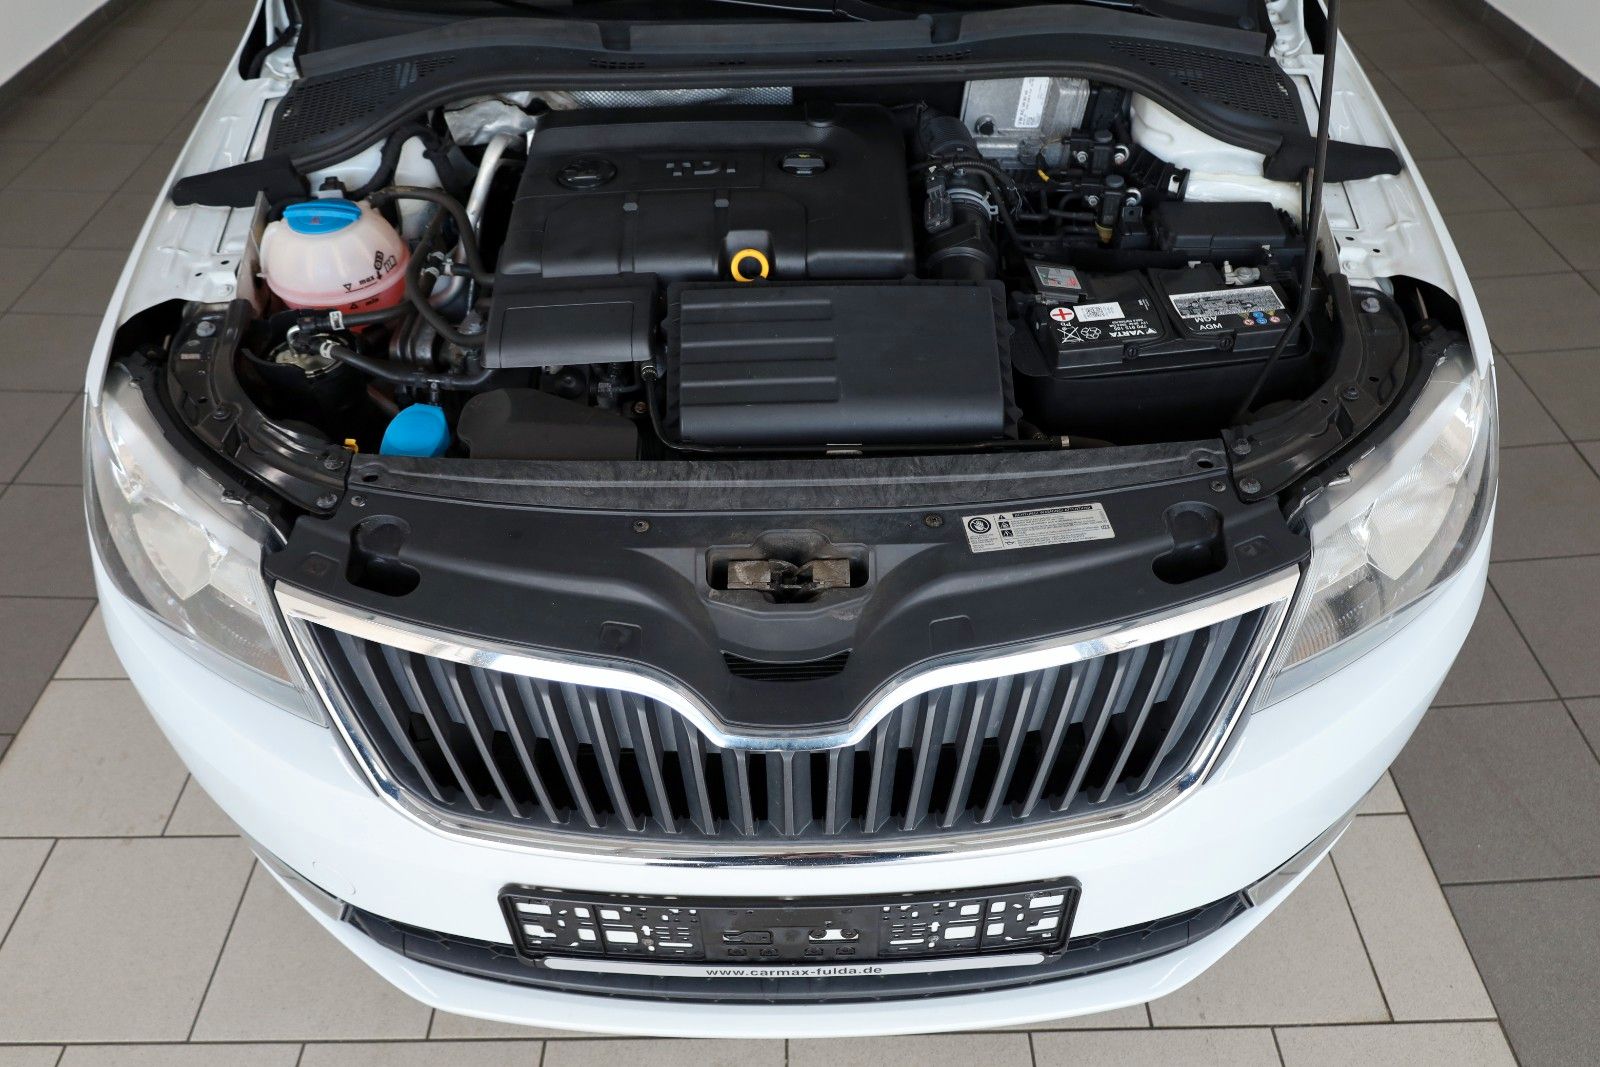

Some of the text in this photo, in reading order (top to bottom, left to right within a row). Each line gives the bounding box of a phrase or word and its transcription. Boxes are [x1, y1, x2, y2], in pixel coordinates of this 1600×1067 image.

[359, 276, 375, 285] max
[1200, 323, 1223, 331] AGM
[706, 966, 883, 976] www.carmax-fulda.de
